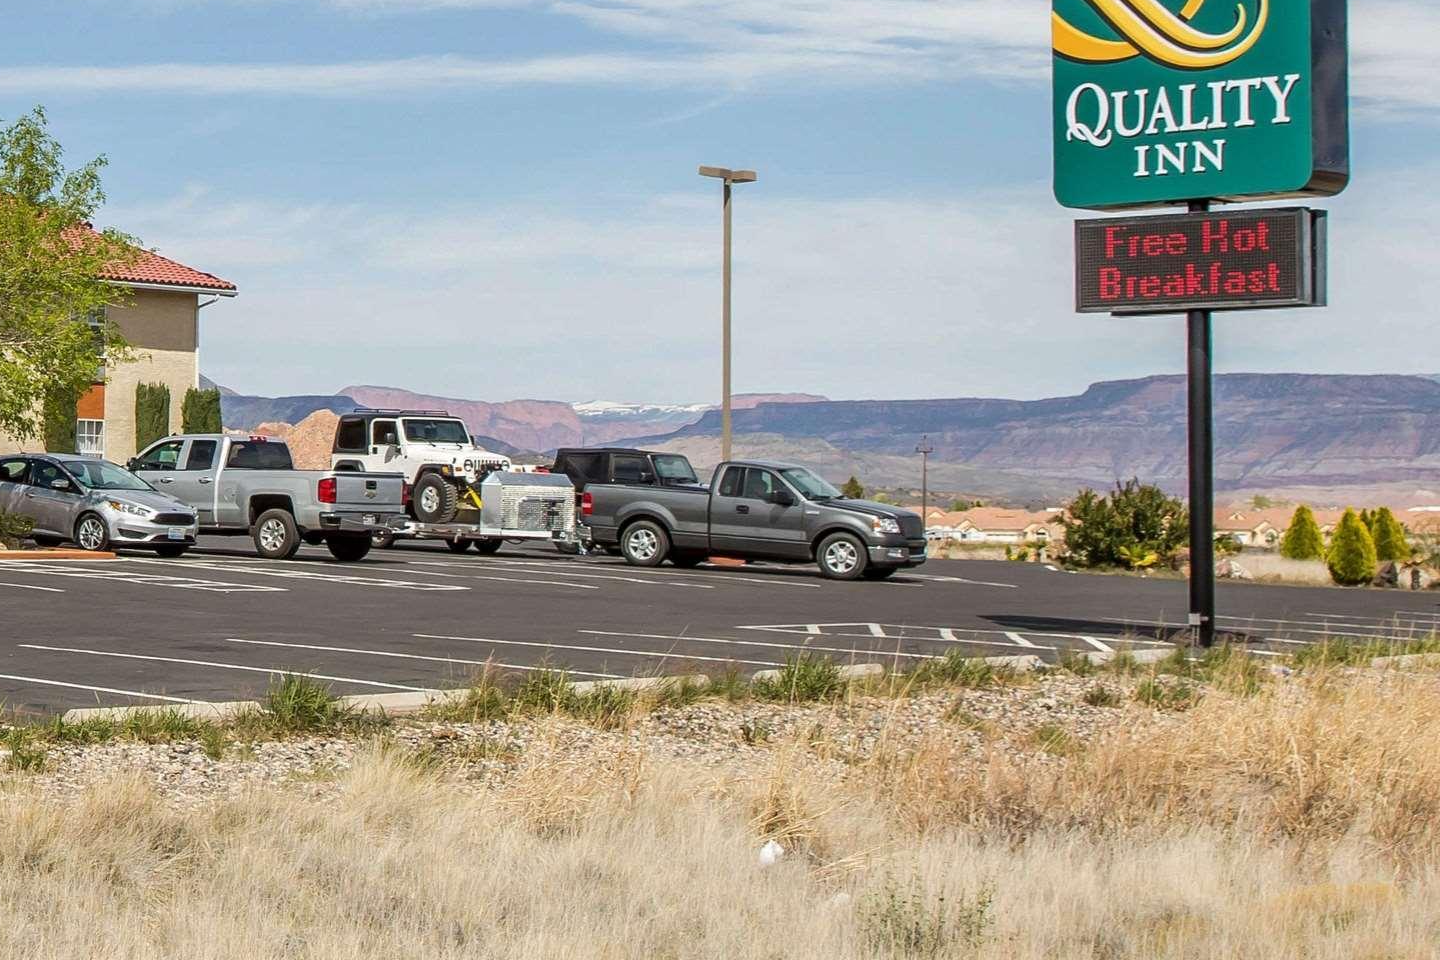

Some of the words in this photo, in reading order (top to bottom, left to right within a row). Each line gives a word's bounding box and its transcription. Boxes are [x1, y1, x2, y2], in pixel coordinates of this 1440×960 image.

[1066, 73, 1301, 148] QUALITY
[1133, 139, 1227, 177] INN
[1105, 225, 1187, 259] Free
[1201, 220, 1270, 254] Hot
[1098, 263, 1281, 300] Breakfast
